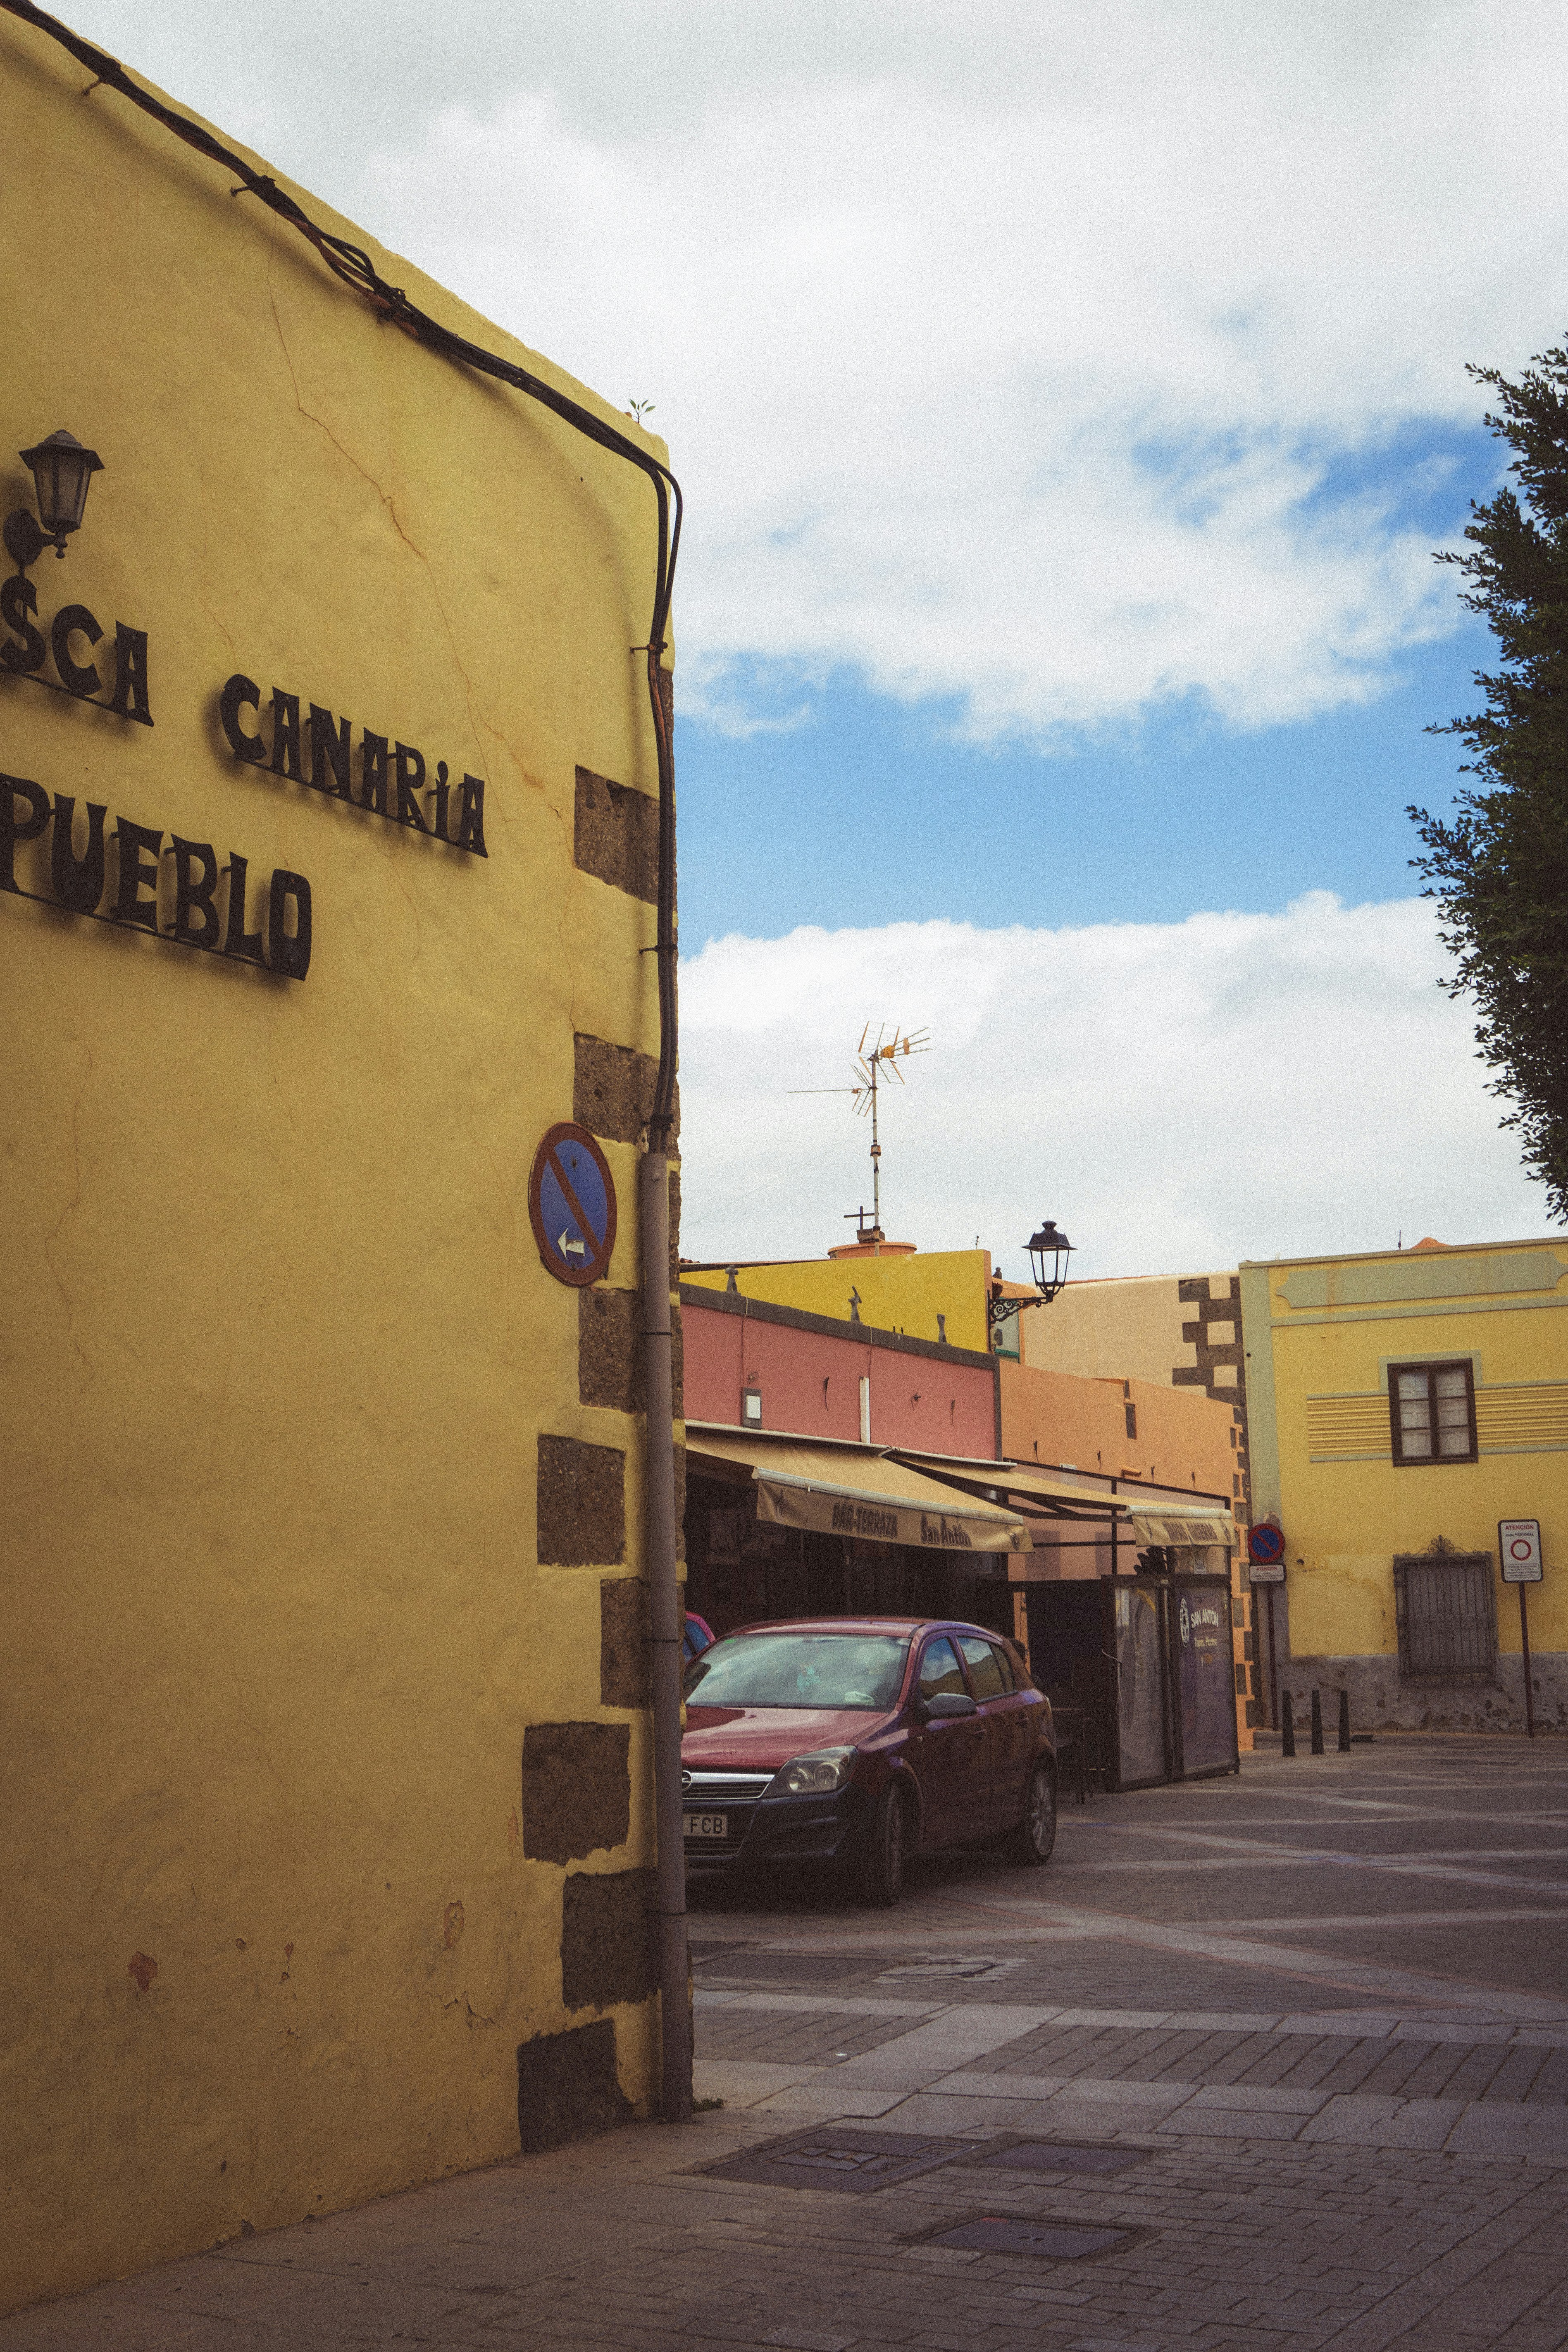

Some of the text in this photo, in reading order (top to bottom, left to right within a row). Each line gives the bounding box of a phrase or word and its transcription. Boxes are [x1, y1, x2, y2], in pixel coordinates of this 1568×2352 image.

[0, 772, 312, 980] PUEBLO
[831, 1502, 972, 1548] BAR-TERRAZA San Antón
[1162, 1521, 1189, 1543] TAPAS
[1191, 1610, 1201, 1629] SAN
[690, 1816, 723, 1834] FCB
